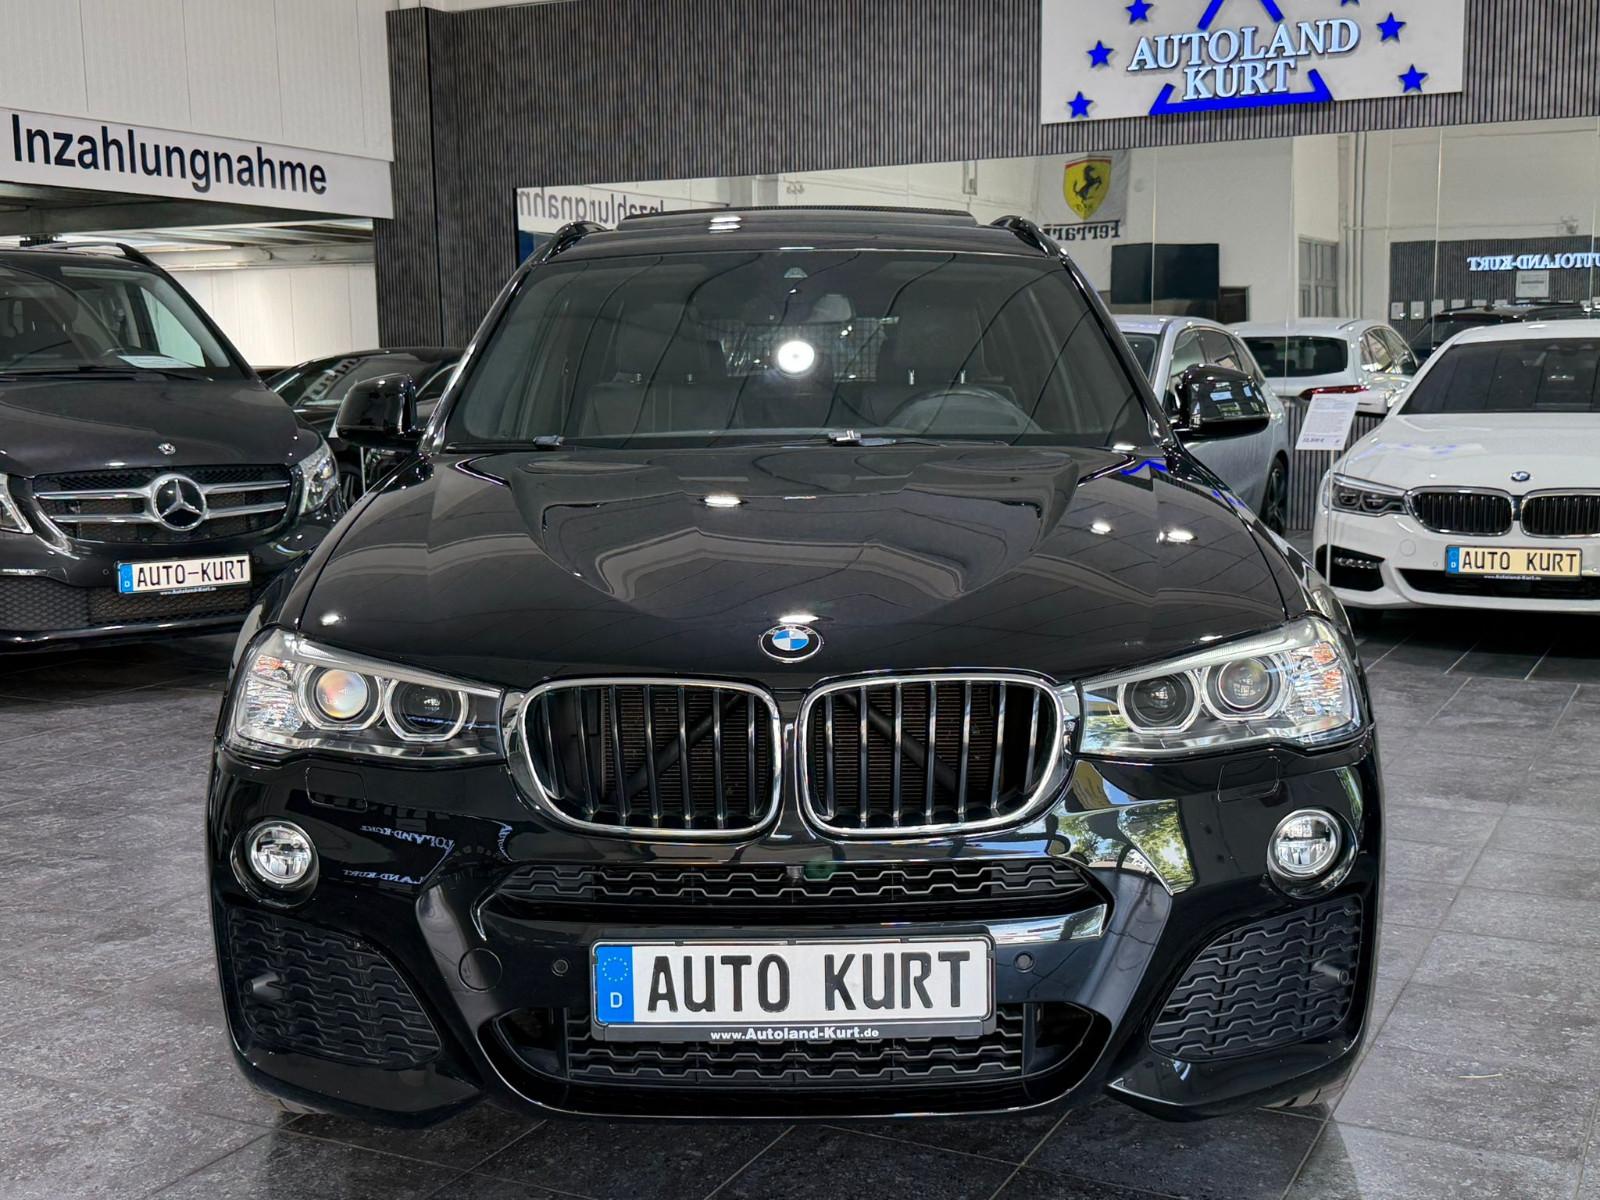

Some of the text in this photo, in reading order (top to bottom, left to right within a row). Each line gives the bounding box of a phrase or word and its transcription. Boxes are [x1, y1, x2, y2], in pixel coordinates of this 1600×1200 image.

[1127, 18, 1361, 71] AUTOLAND
[1183, 58, 1297, 100] KURT
[12, 113, 326, 194] Inzahlungnahme
[137, 560, 246, 587] AUTO-KURT
[1462, 551, 1511, 570] AUTO
[1526, 552, 1577, 572] KURT
[610, 951, 970, 1013] D AUTO KURT
[711, 1027, 879, 1040] www.Autoland-Kurt.de
